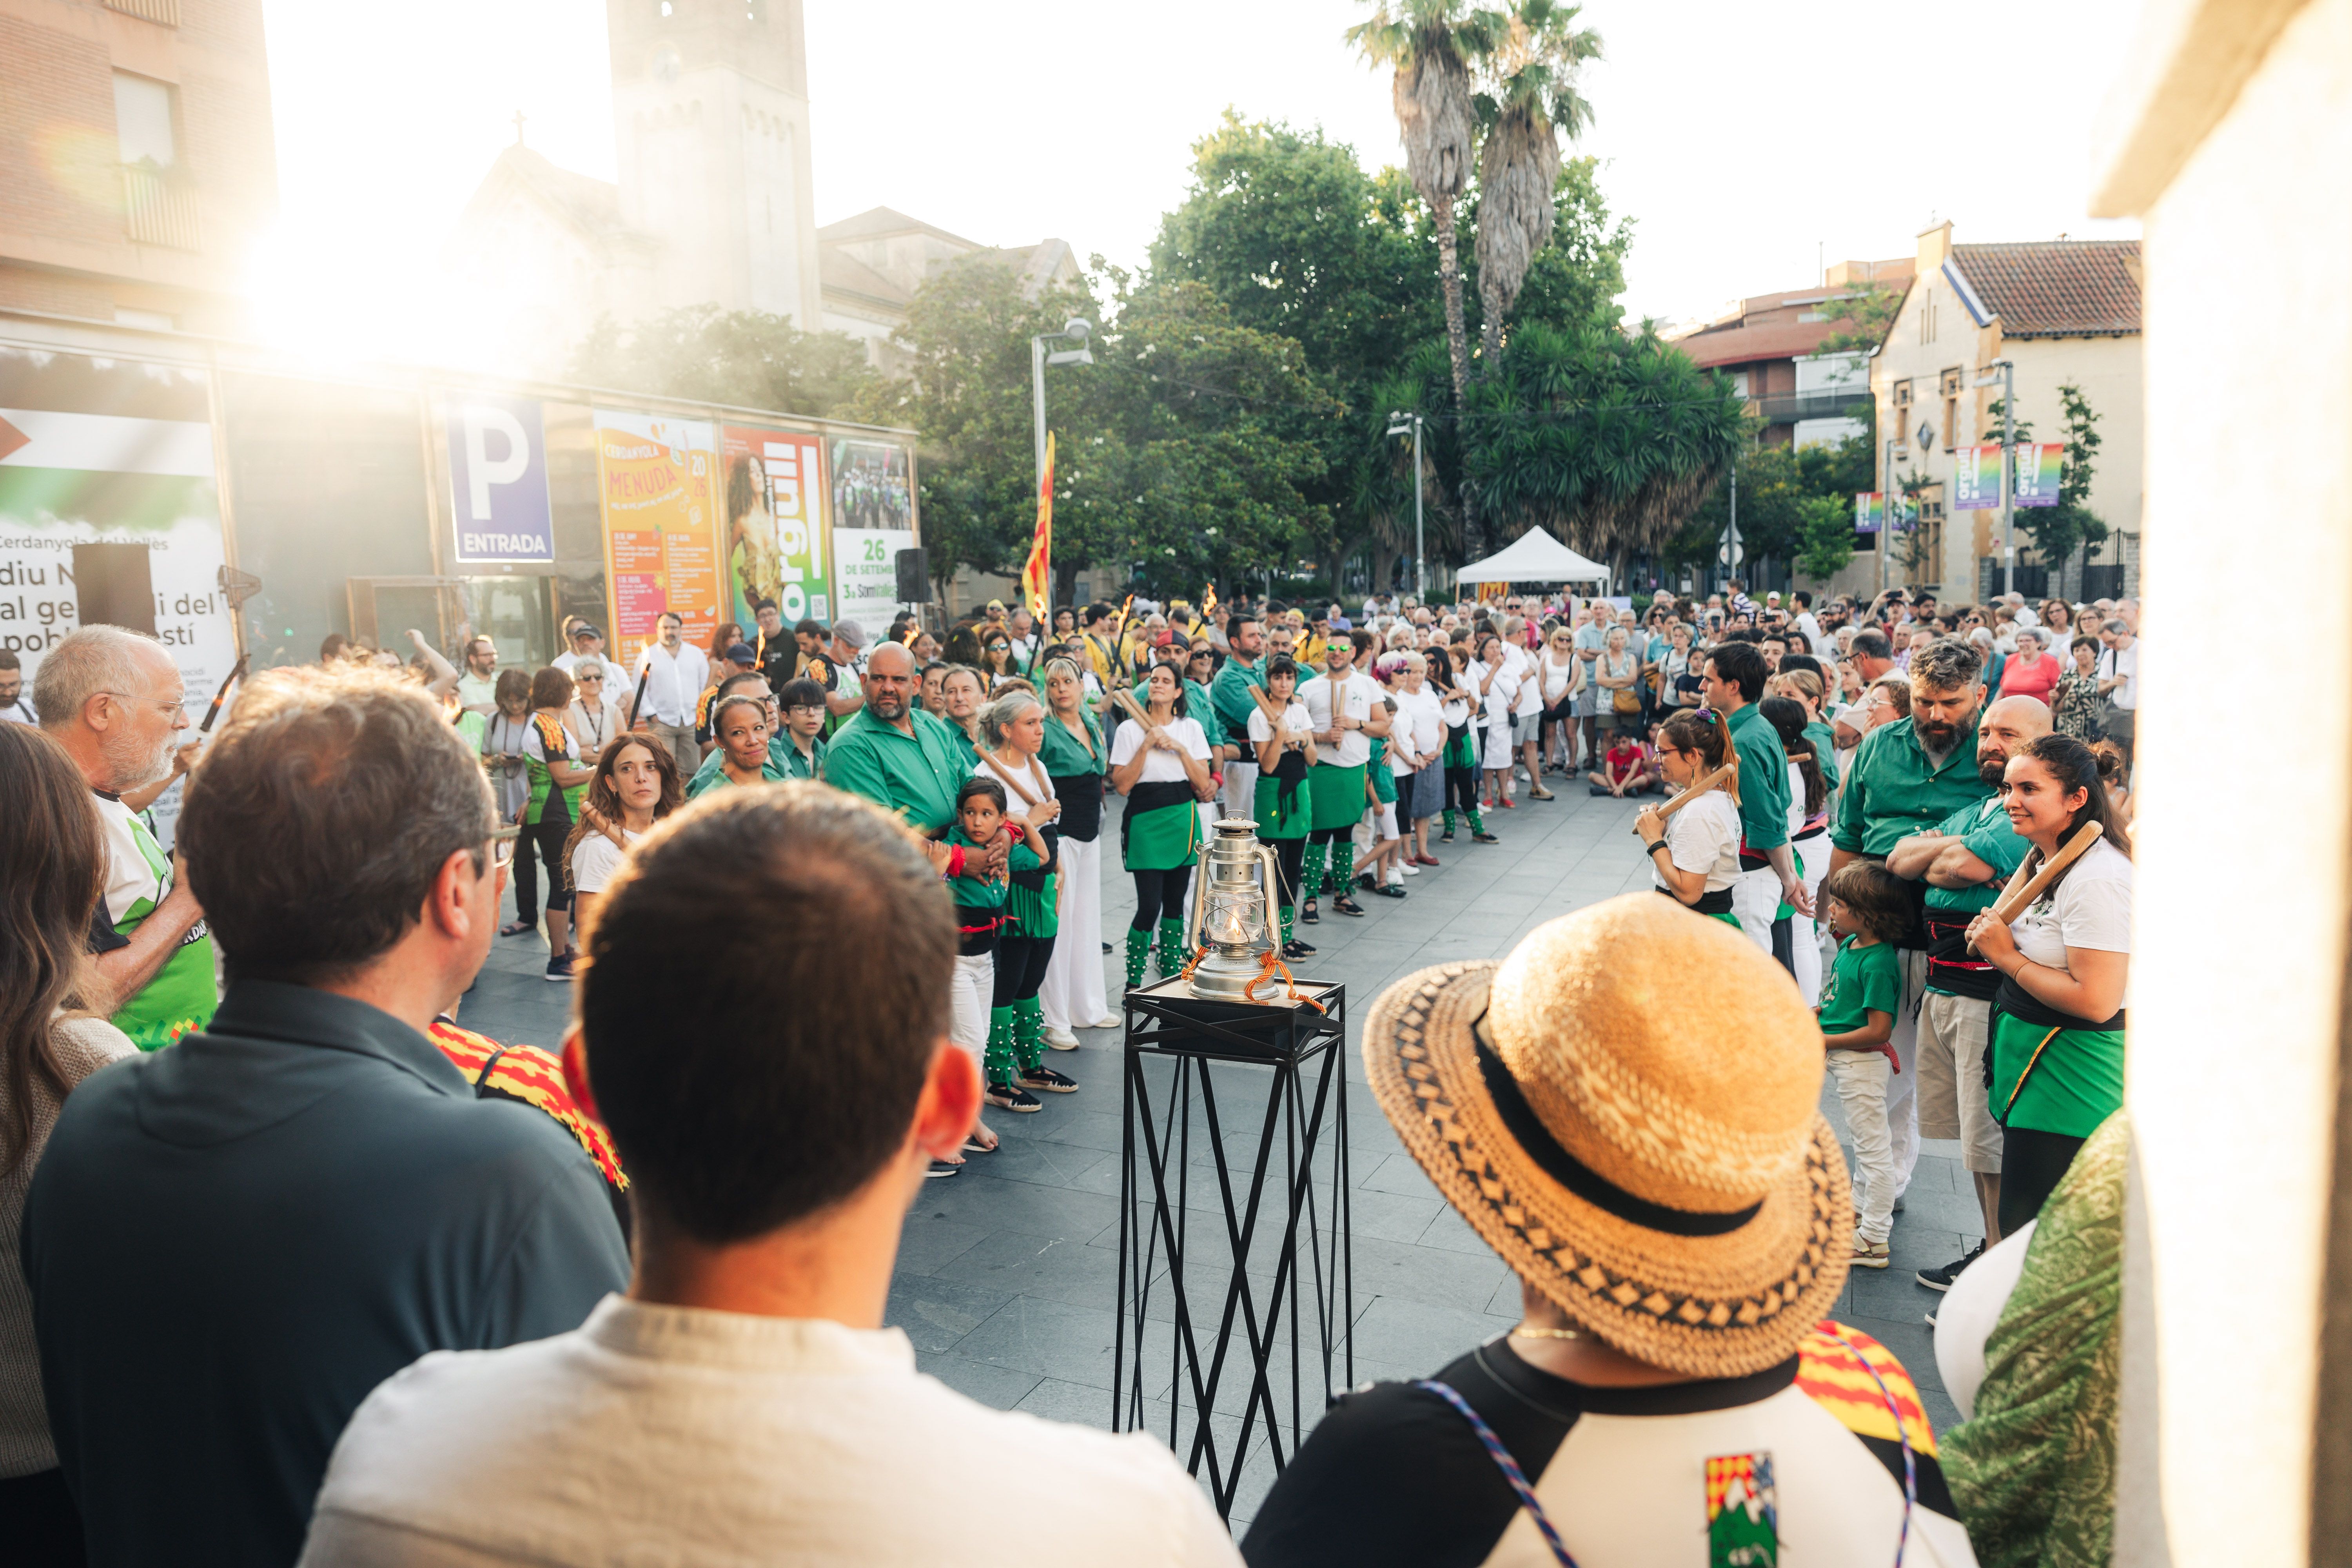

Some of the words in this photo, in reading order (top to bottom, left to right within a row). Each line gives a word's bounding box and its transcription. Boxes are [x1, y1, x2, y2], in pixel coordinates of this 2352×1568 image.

[463, 405, 530, 520] P
[605, 444, 659, 459] CERDANYOLA
[692, 455, 706, 477] 20
[609, 464, 677, 497] MENUDA
[693, 477, 707, 497] 26
[463, 532, 547, 553] ENTRADA
[864, 539, 885, 561] 26
[846, 564, 857, 574] DE
[860, 564, 894, 574] SETEMB
[0, 596, 25, 620] al
[175, 593, 214, 615] del
